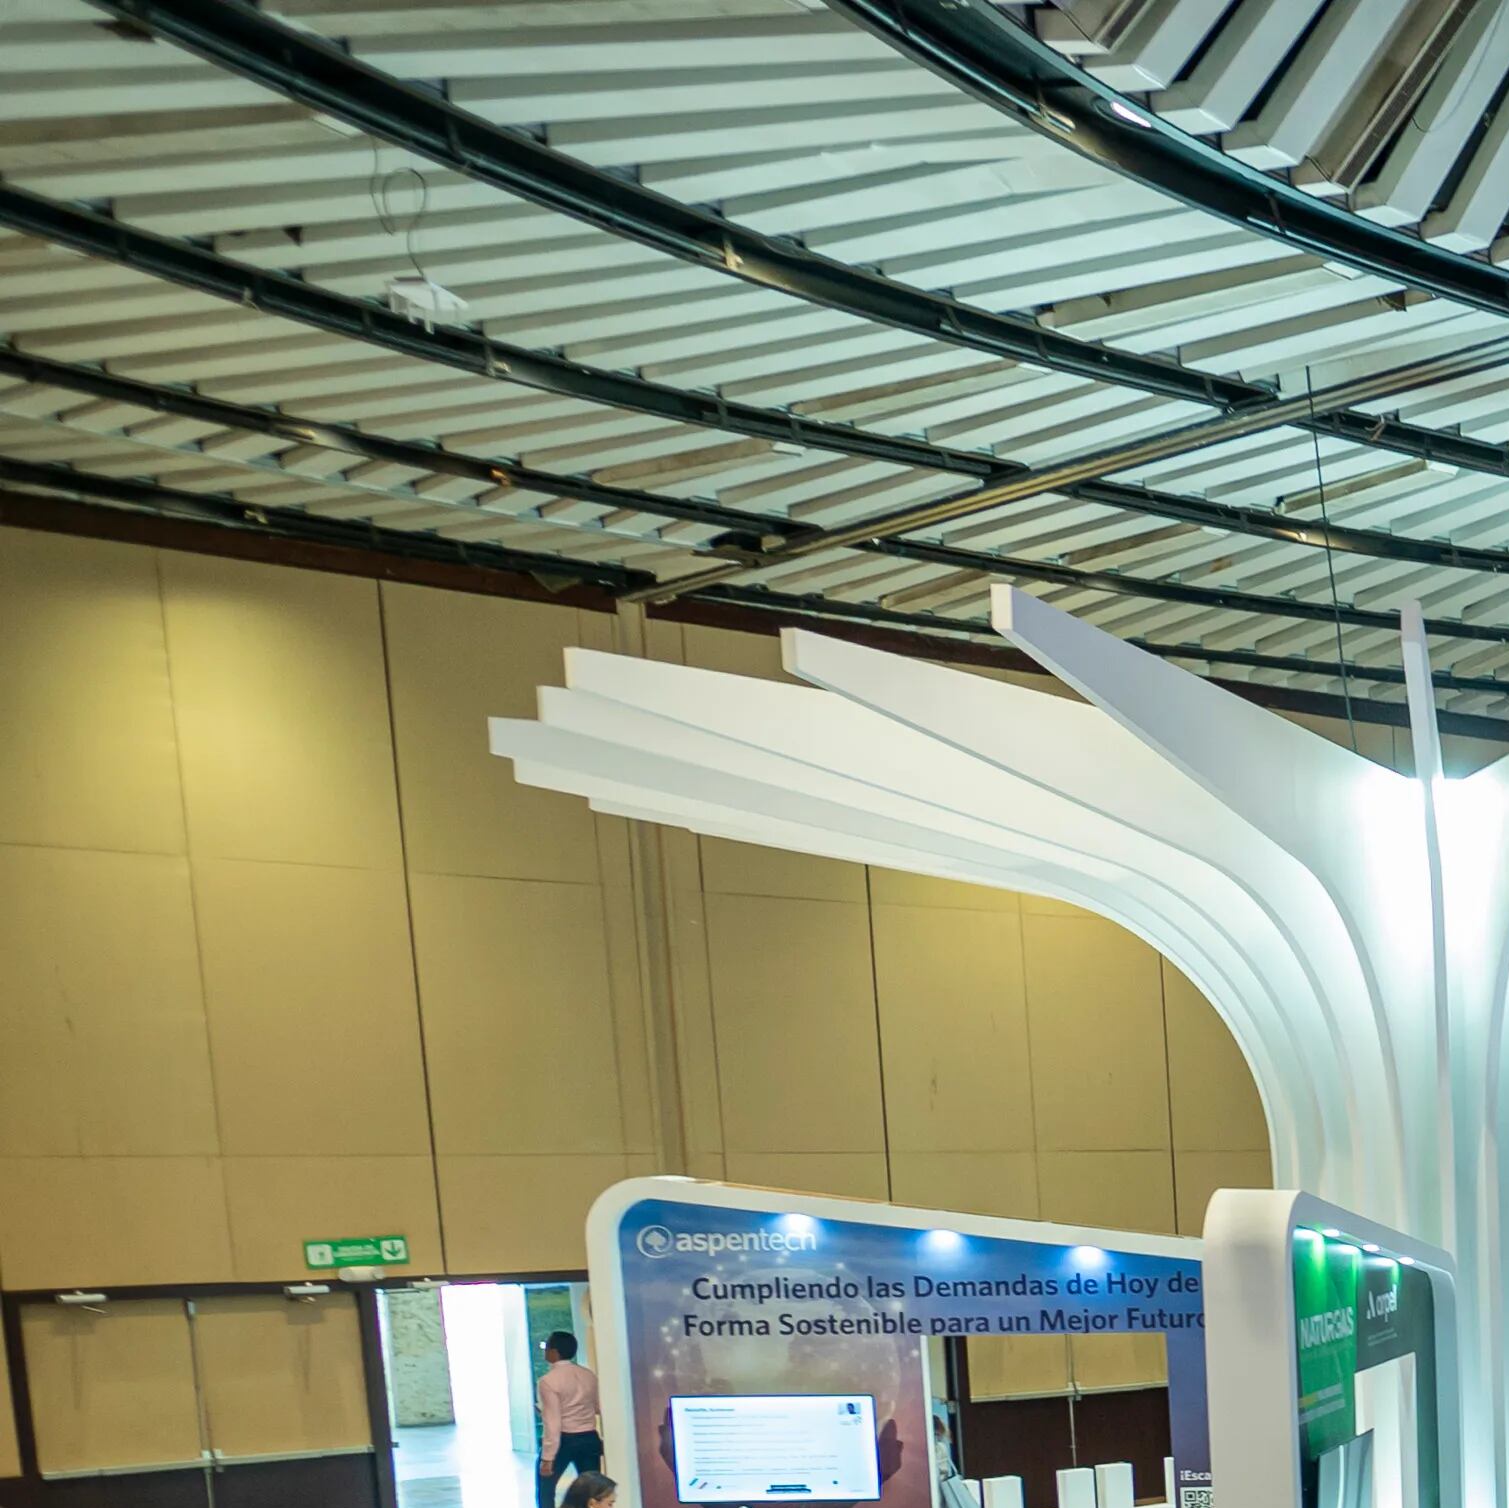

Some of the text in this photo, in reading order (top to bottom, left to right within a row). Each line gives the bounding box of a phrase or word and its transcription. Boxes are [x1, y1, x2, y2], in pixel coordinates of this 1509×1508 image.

[675, 1227, 817, 1257] aspentech
[691, 1270, 1199, 1304] Cumpliendo las Demandas de Hoy de
[683, 1314, 771, 1338] Forma
[778, 1311, 923, 1338] Sostenible
[930, 1316, 991, 1336] para
[999, 1313, 1032, 1333] un
[1039, 1308, 1119, 1334] Mejor
[1300, 1306, 1354, 1350] NATURGAS
